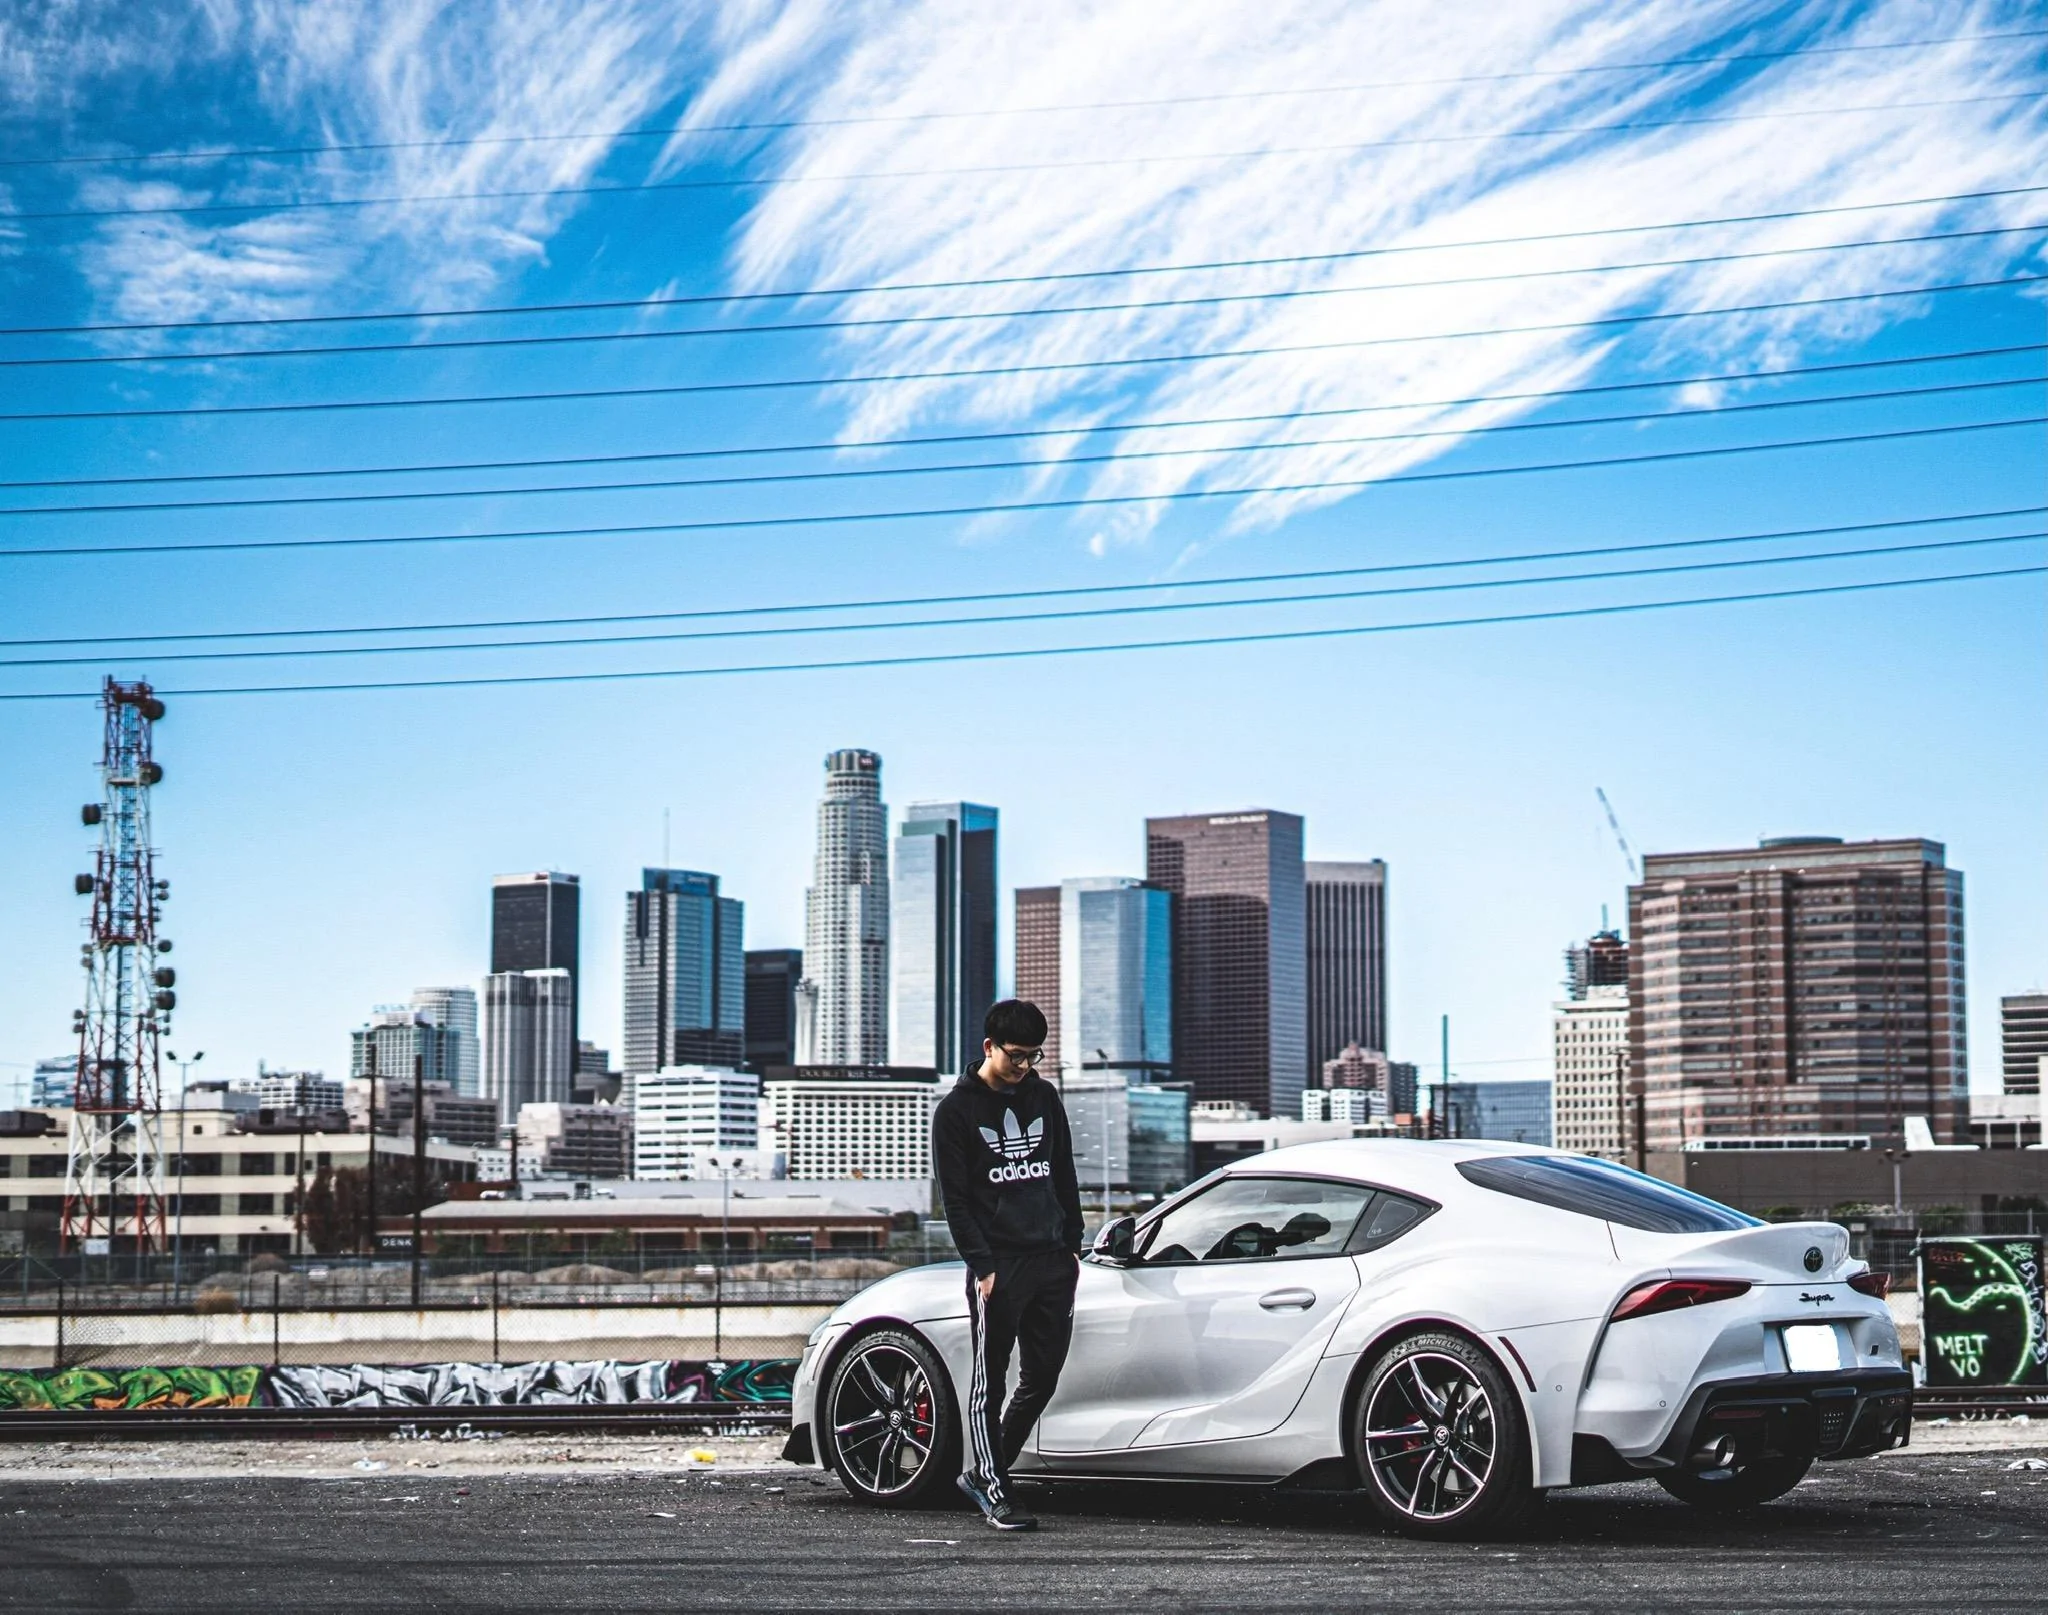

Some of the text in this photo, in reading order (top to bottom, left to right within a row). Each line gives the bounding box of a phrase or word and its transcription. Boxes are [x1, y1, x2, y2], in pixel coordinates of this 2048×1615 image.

[988, 1160, 1050, 1183] adidas
[1799, 1292, 1835, 1307] Supra
[1417, 1338, 1463, 1352] MICHELIN
[1934, 1334, 1988, 1356] MELT
